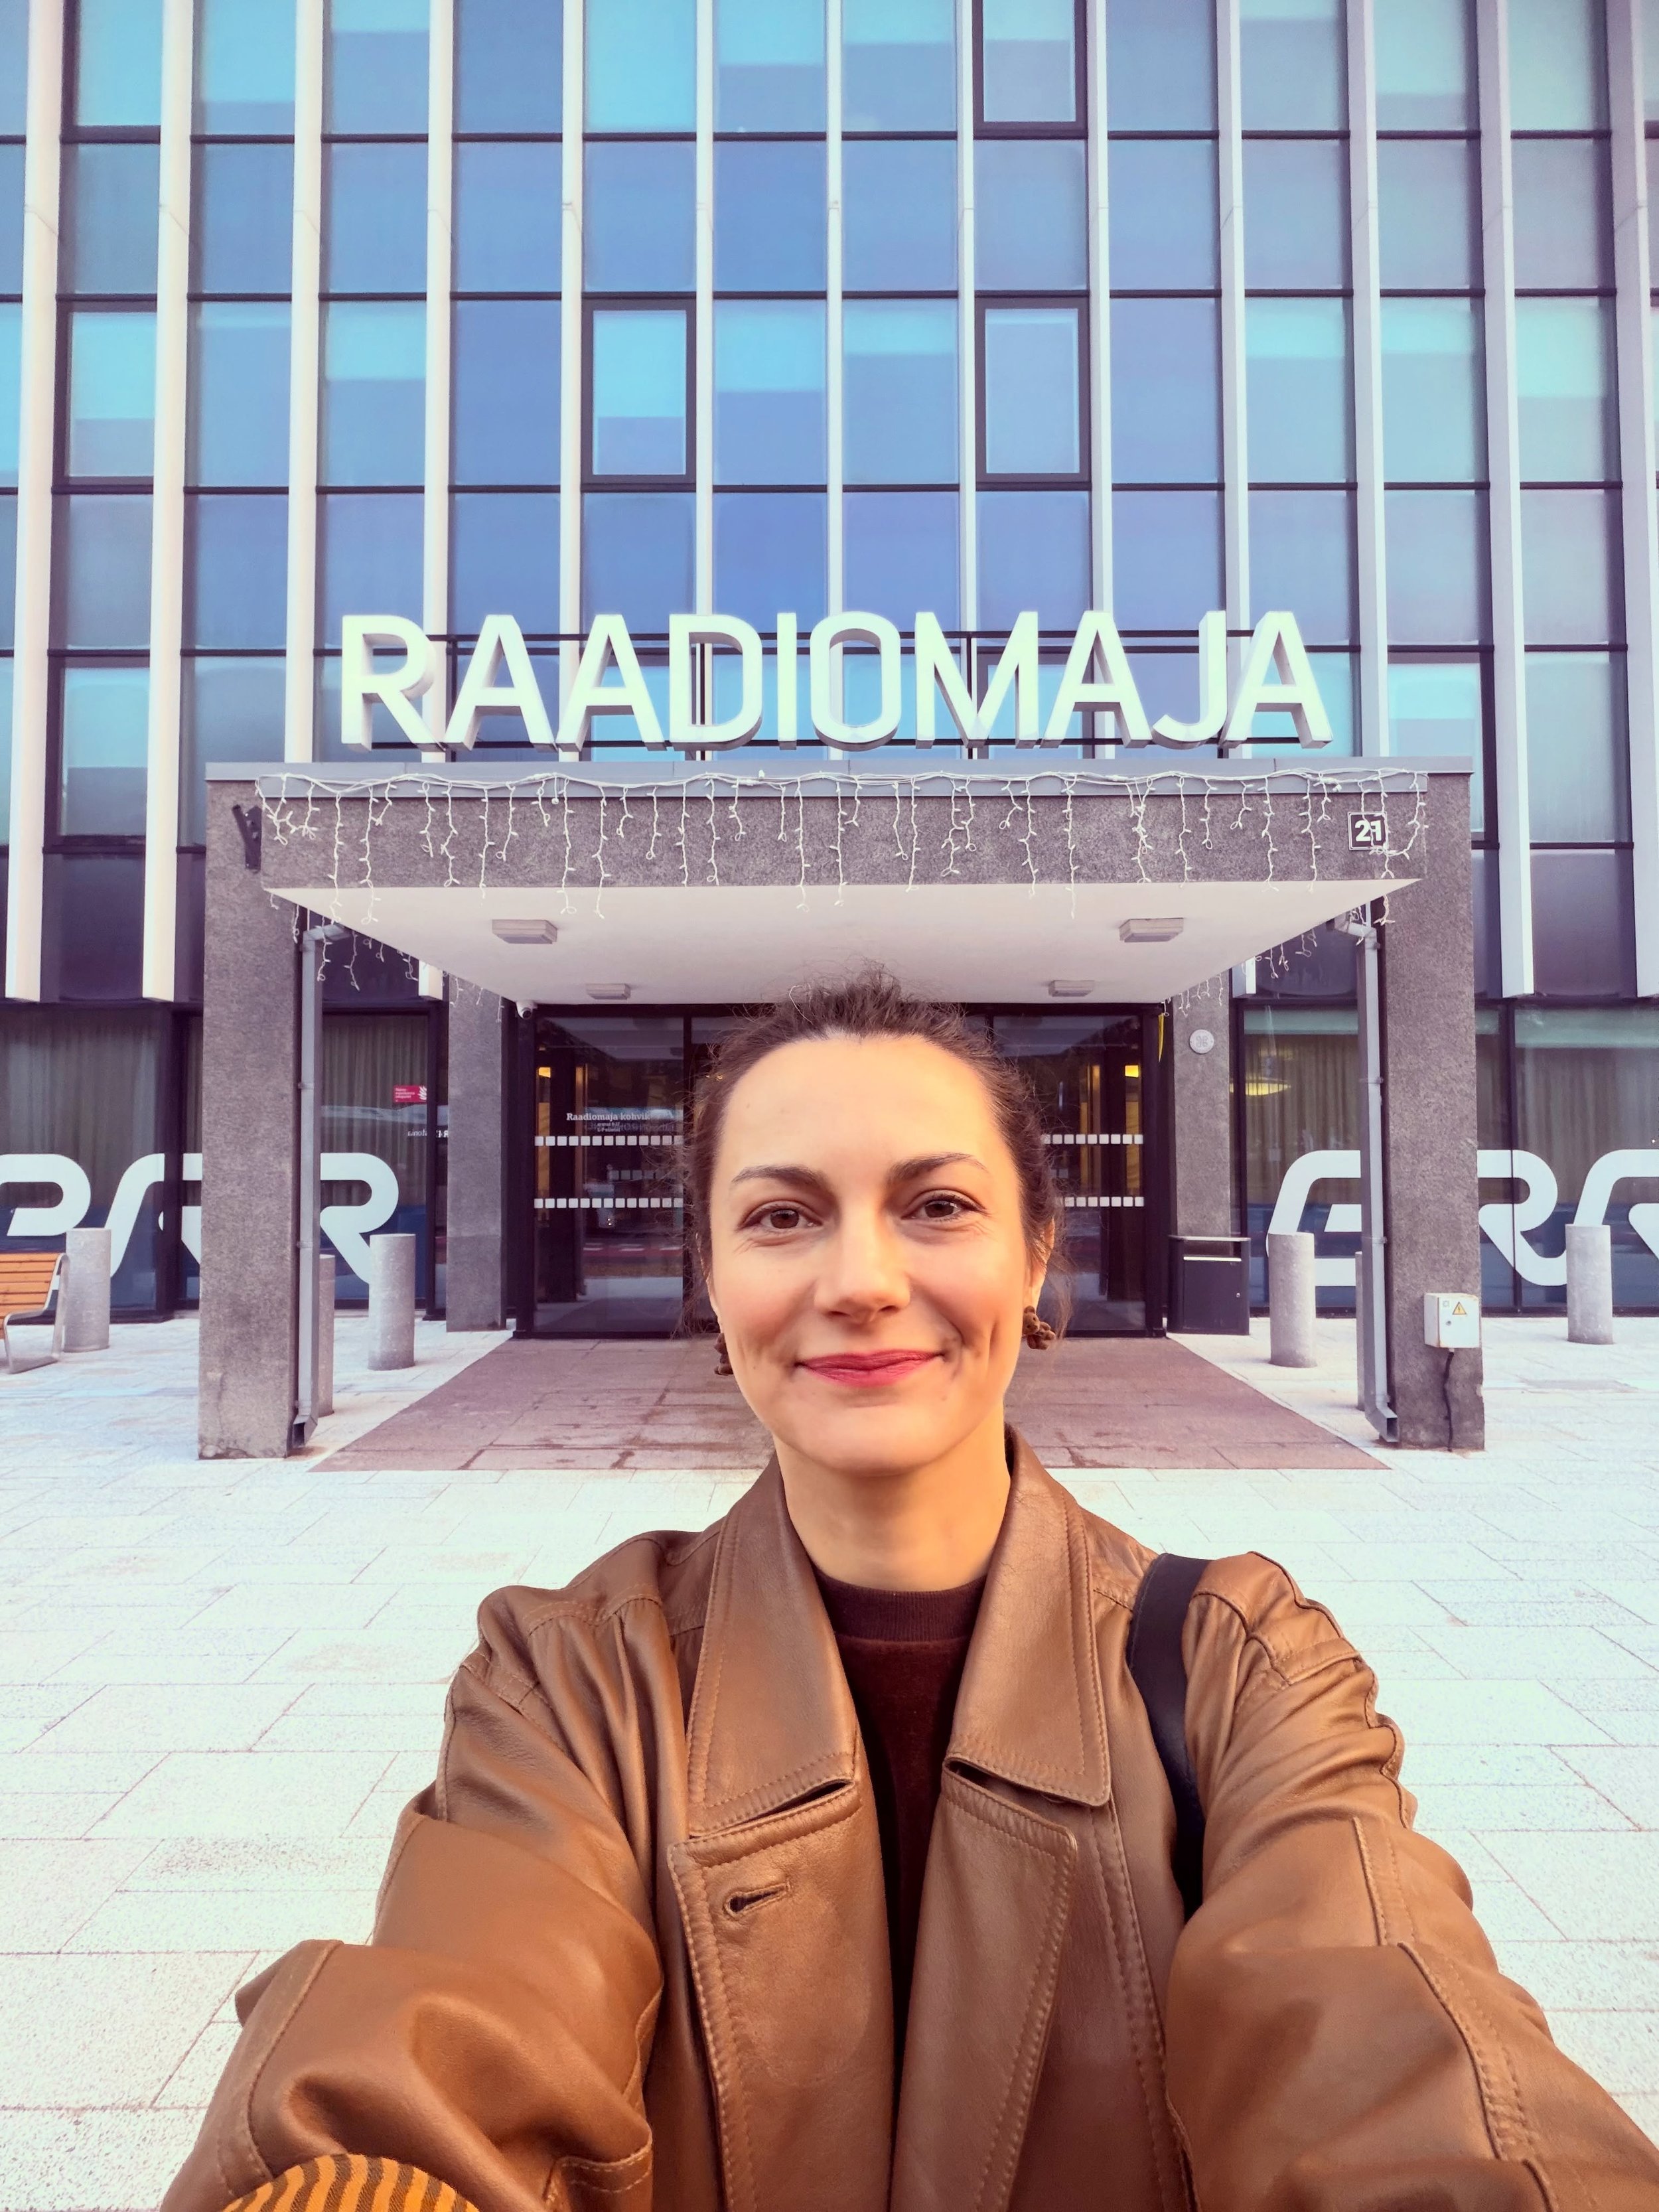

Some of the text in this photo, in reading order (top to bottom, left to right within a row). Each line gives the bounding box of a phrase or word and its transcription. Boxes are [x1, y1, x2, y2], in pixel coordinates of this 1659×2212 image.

[341, 611, 1333, 751] RAADIOMAJA
[1354, 820, 1382, 842] 21
[566, 1112, 650, 1122] Raadiomaja kohvik
